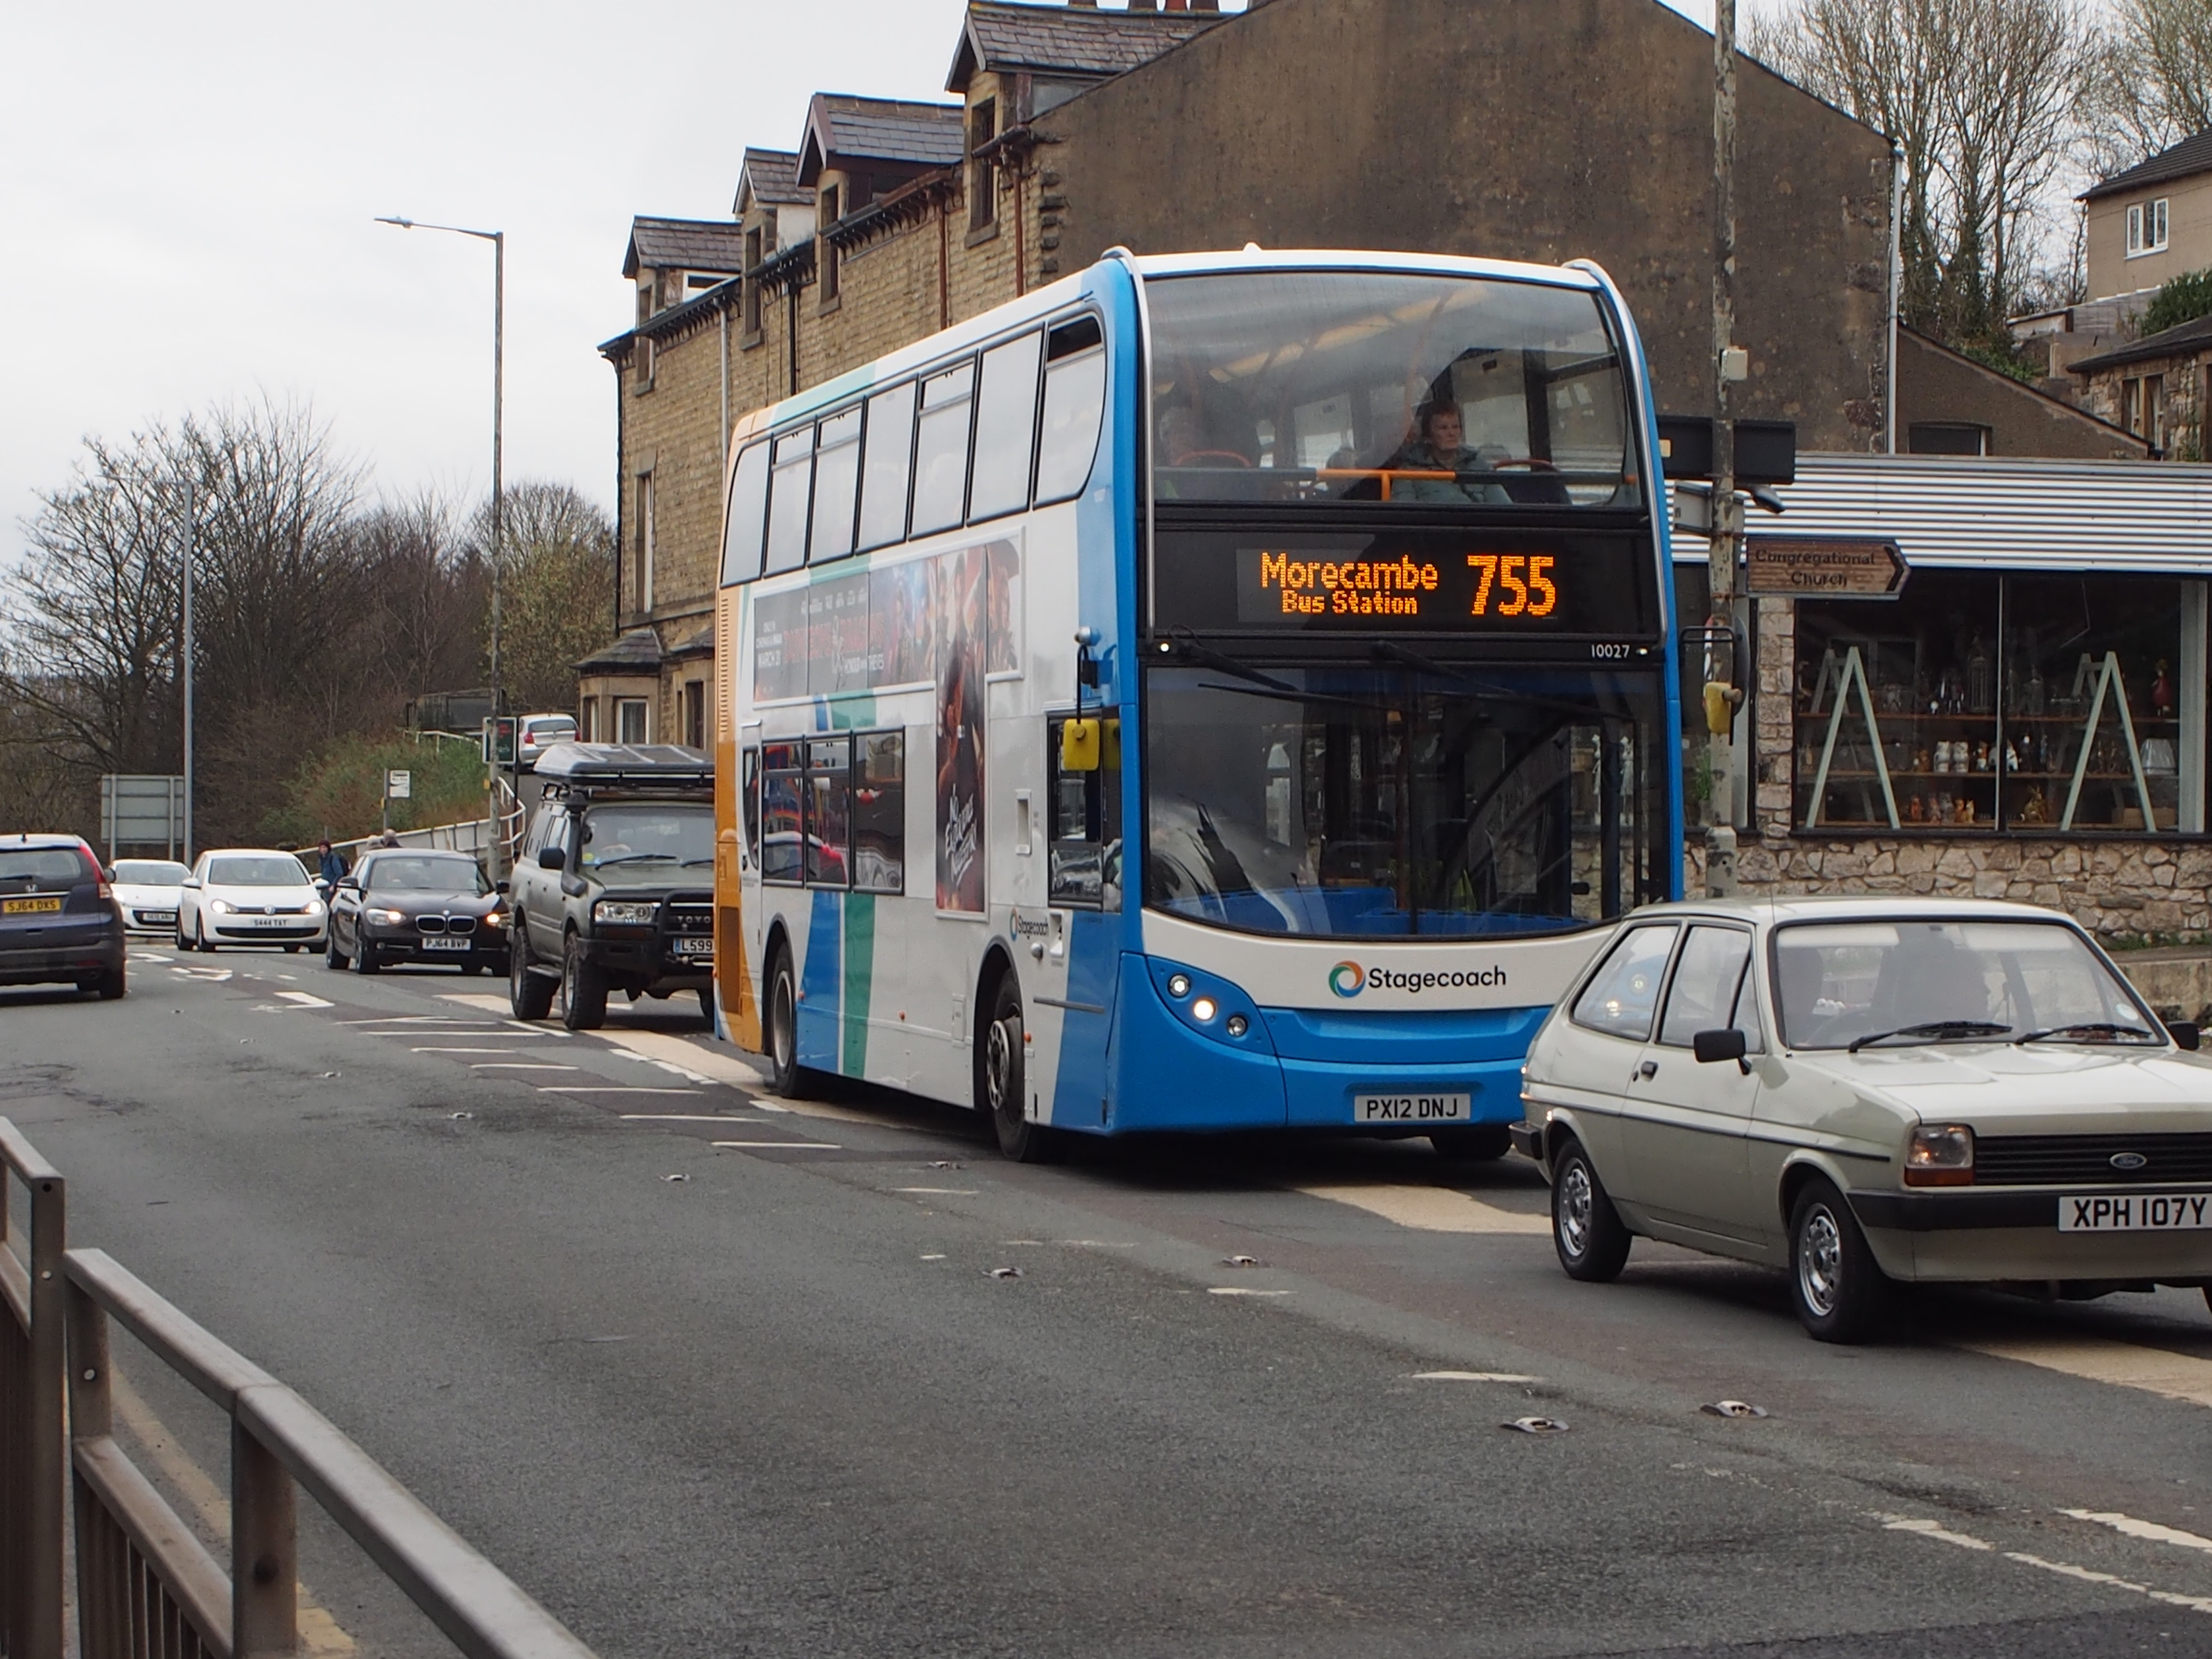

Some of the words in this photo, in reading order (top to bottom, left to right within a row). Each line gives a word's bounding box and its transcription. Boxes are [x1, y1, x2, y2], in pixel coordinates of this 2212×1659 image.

[1755, 550, 1875, 565] Congregational
[1261, 552, 1438, 590] Morecambe
[1467, 555, 1556, 616] 755
[1791, 571, 1847, 587] Church
[1282, 589, 1325, 613] Bus
[1332, 590, 1418, 615] Station
[1591, 643, 1630, 659] 10027
[8, 902, 35, 911] SJ64
[37, 900, 56, 910] DXS
[1018, 914, 1048, 940] Stagecoach
[682, 939, 713, 951] L599
[1369, 964, 1507, 993] Stagecoach
[1367, 1098, 1412, 1119] PX12
[1418, 1097, 1457, 1118] DNJ
[2073, 1199, 2130, 1227] XPH
[2141, 1197, 2207, 1226] 107Y
